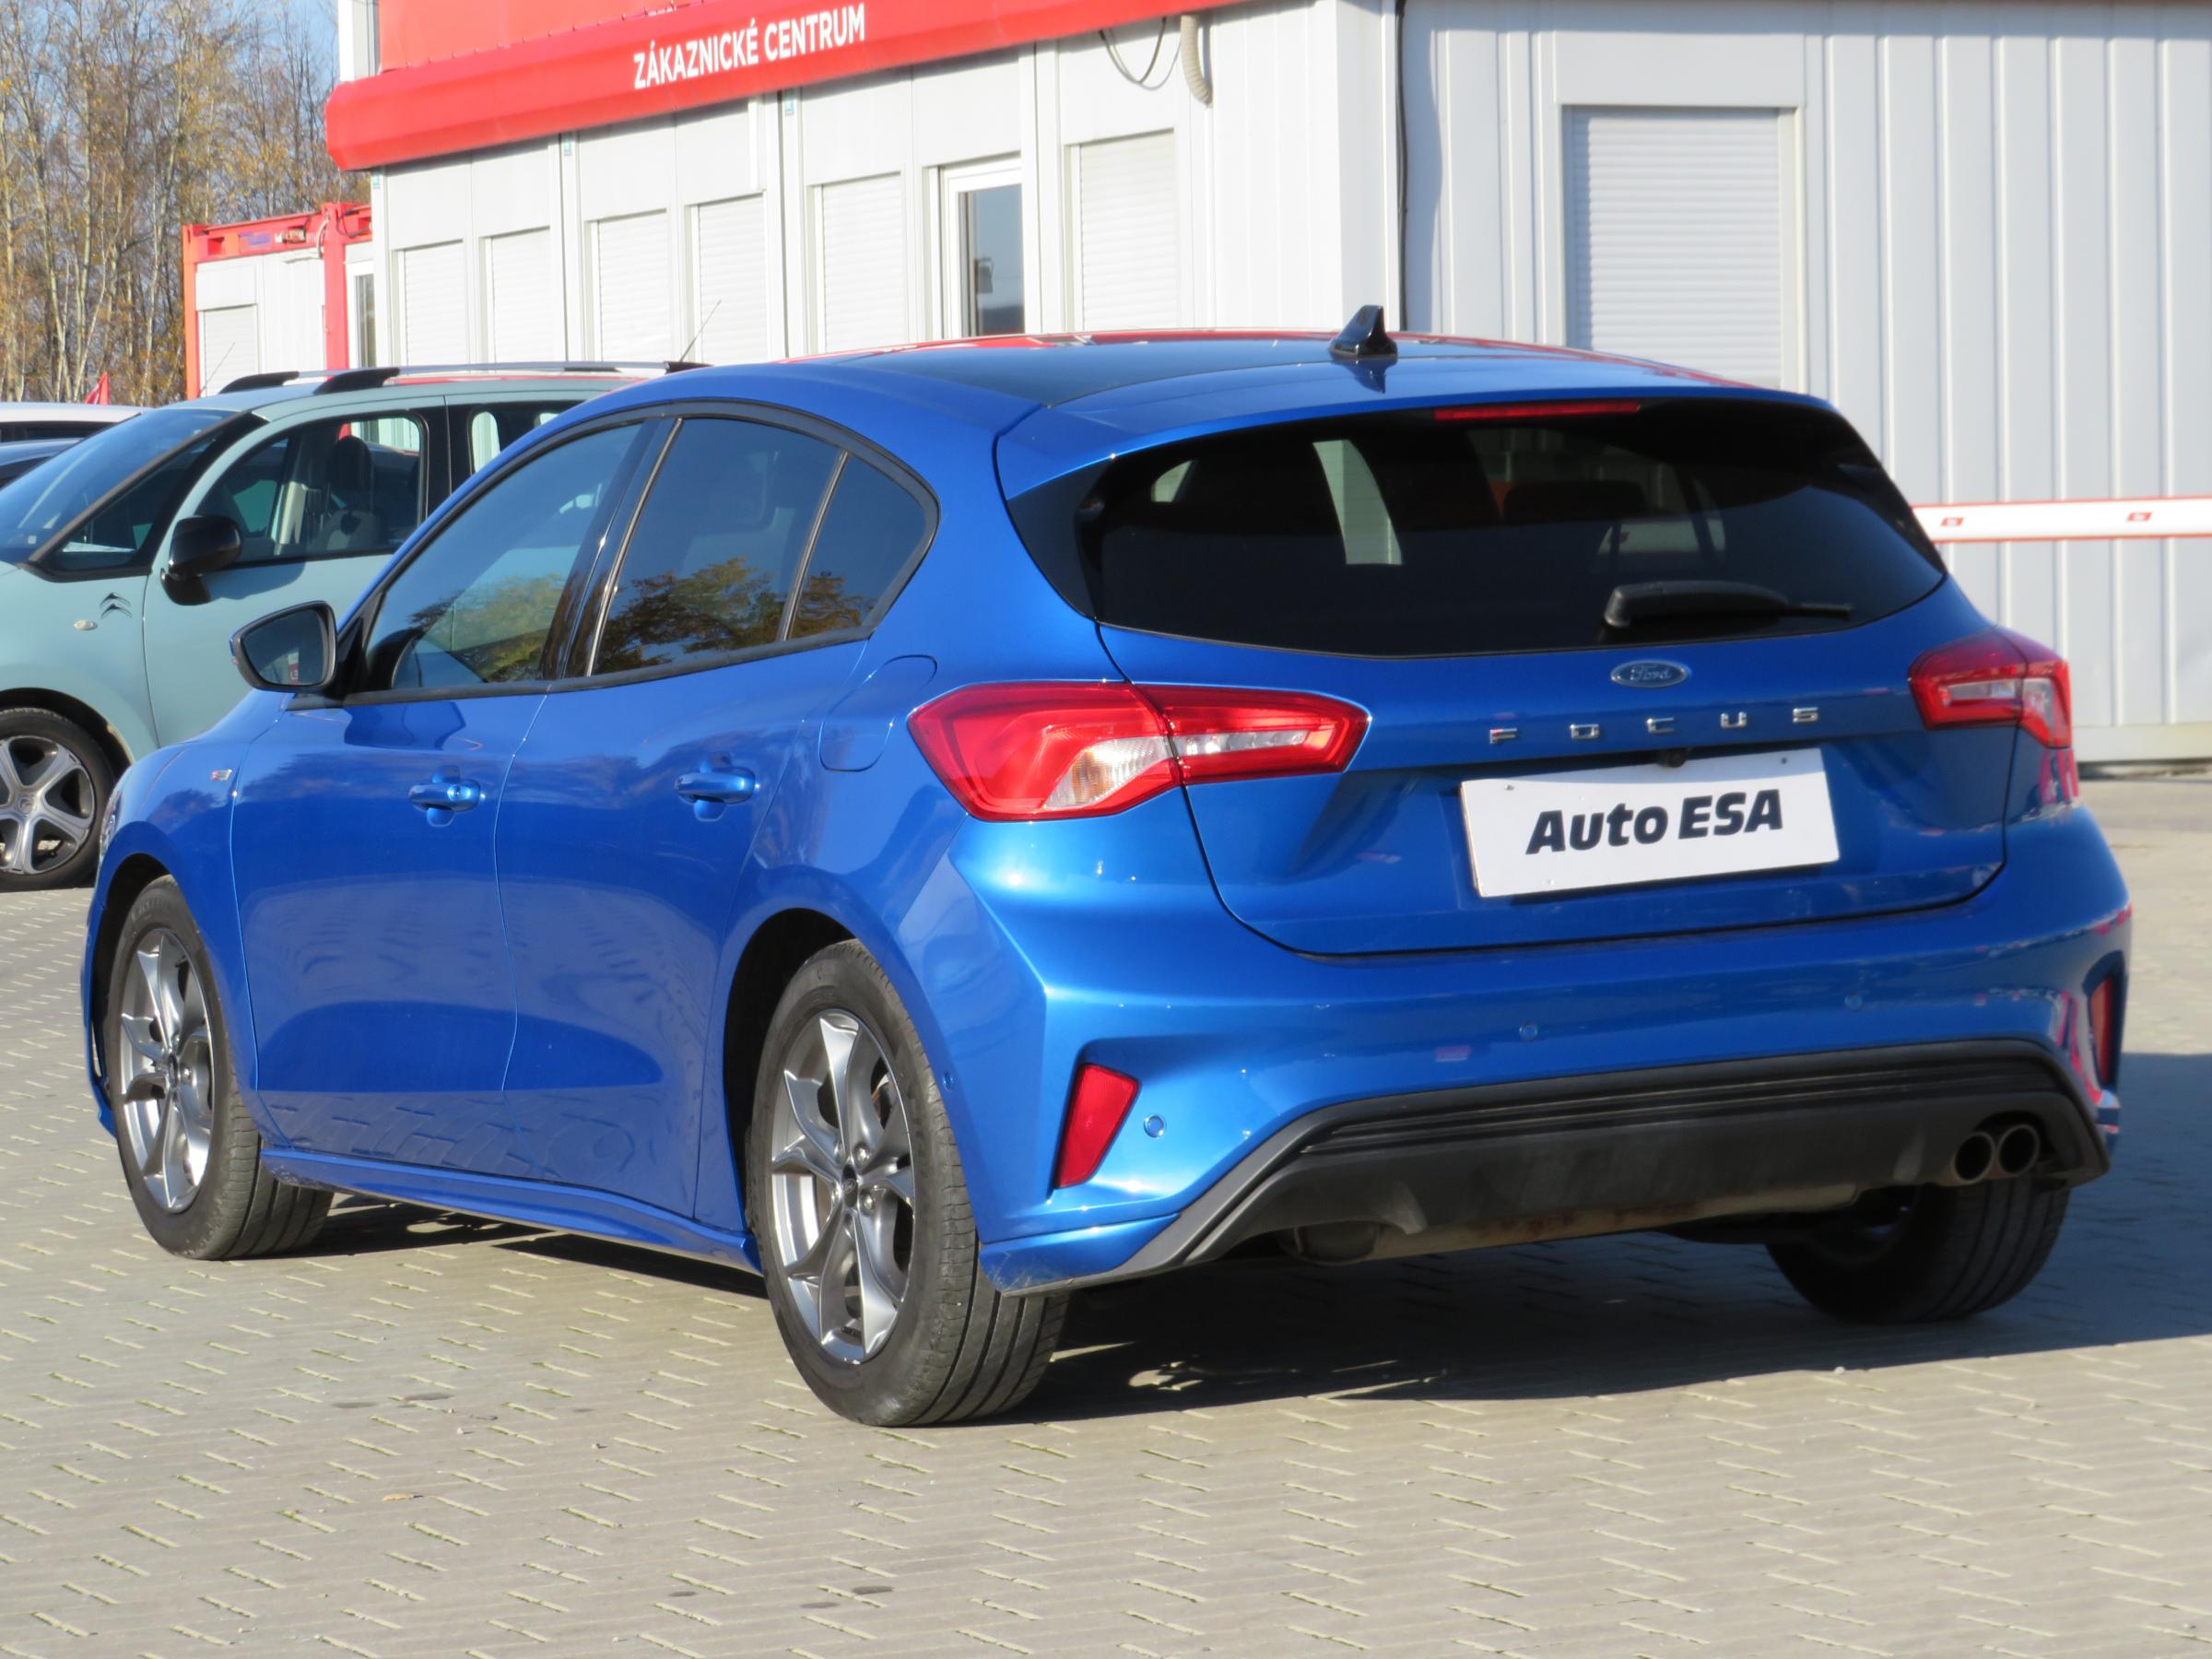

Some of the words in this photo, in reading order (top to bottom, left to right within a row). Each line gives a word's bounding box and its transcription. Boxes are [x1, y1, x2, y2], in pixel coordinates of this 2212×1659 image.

[633, 18, 759, 89] ZÁKAZNICKÉ
[765, 3, 865, 62] CENTRUM
[1630, 665, 1673, 681] Ford
[1489, 707, 1820, 744] FOCUS
[1525, 803, 1668, 854] Auto
[1678, 789, 1783, 840] ESA
